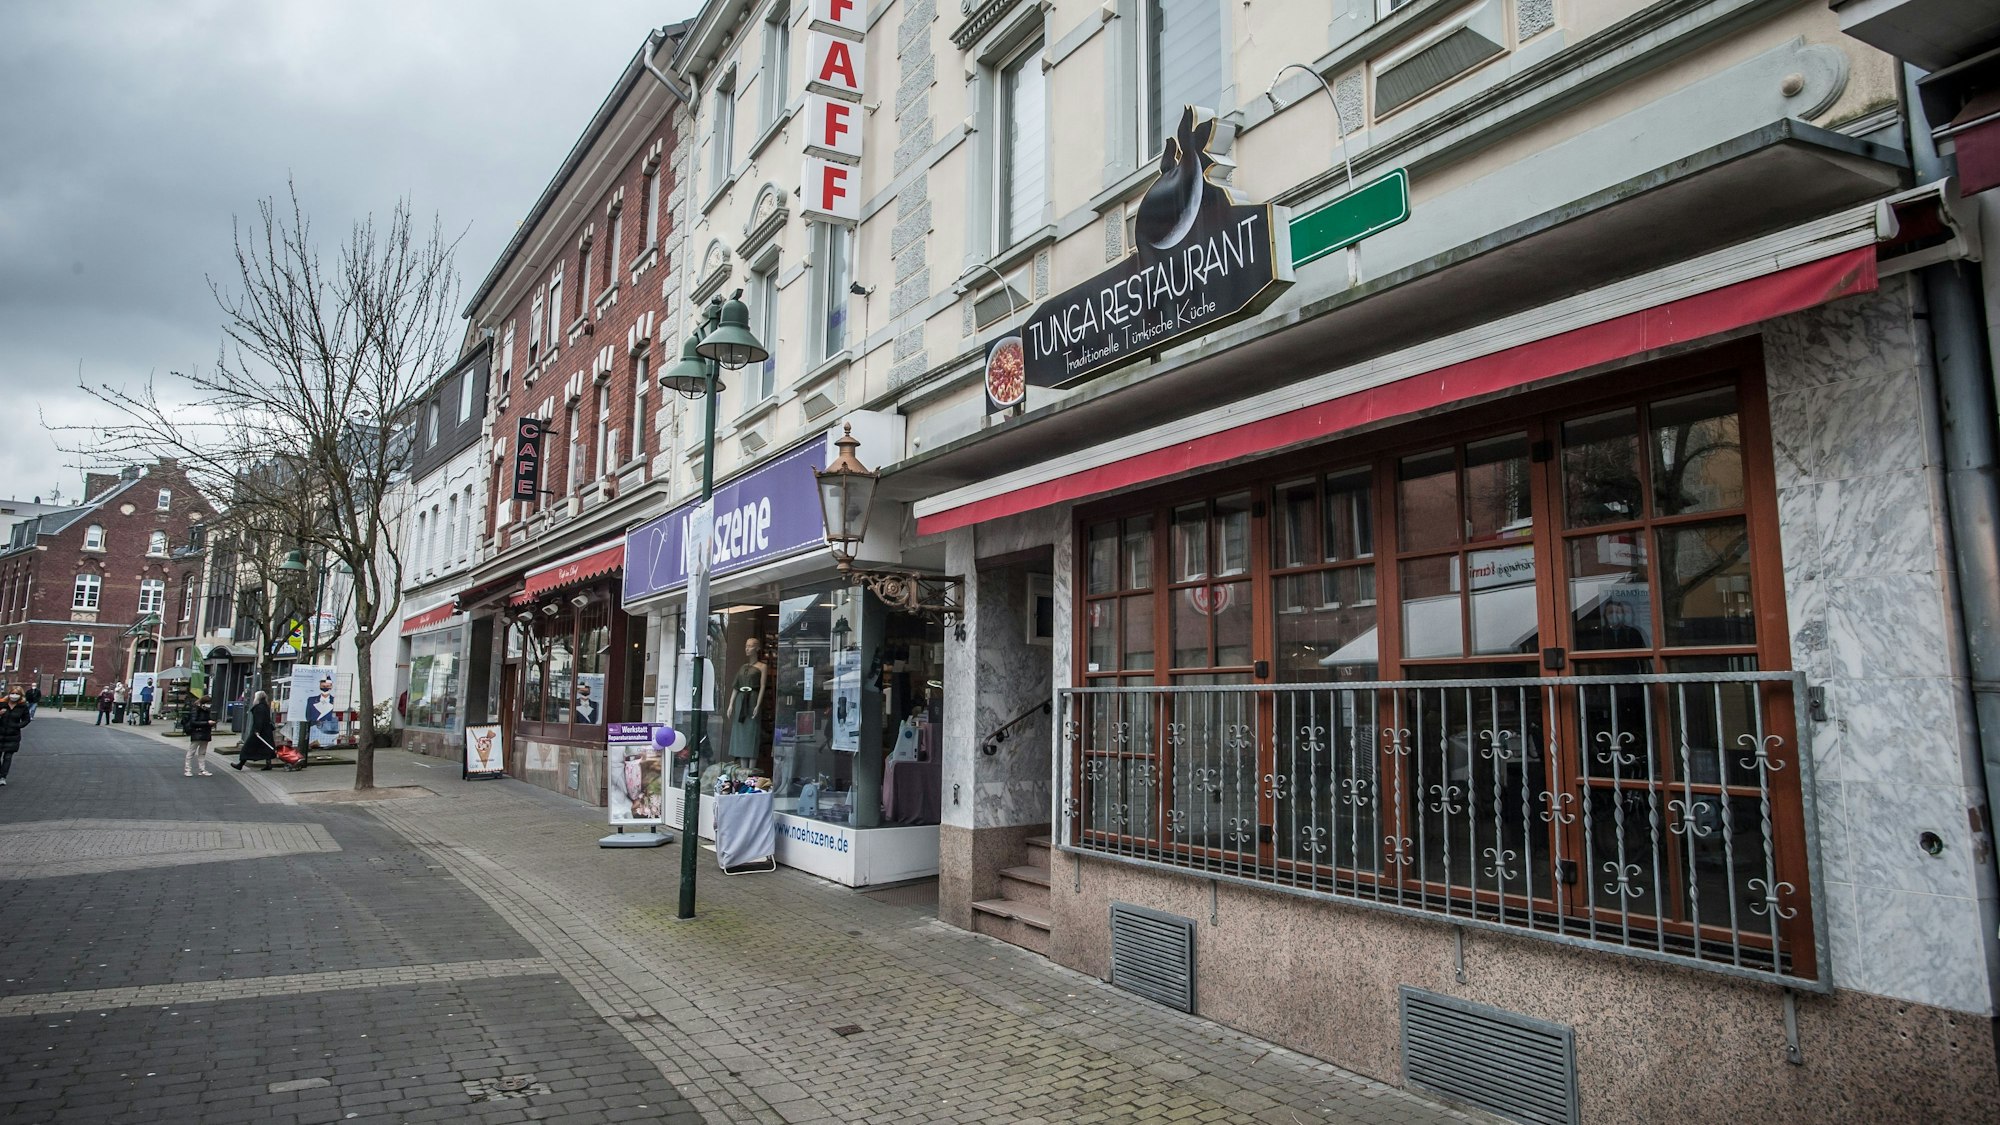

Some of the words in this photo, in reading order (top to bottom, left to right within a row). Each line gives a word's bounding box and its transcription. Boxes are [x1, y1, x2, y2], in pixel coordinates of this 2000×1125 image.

[1029, 297, 1099, 360] TUNGA
[1100, 214, 1258, 331] RESTAURANT
[1063, 333, 1119, 374] Traditionelle
[1122, 311, 1173, 350] Türkische
[1177, 292, 1216, 328] Küche
[518, 423, 539, 495] CAFE
[680, 496, 771, 576] Nszene
[954, 623, 967, 642] 46
